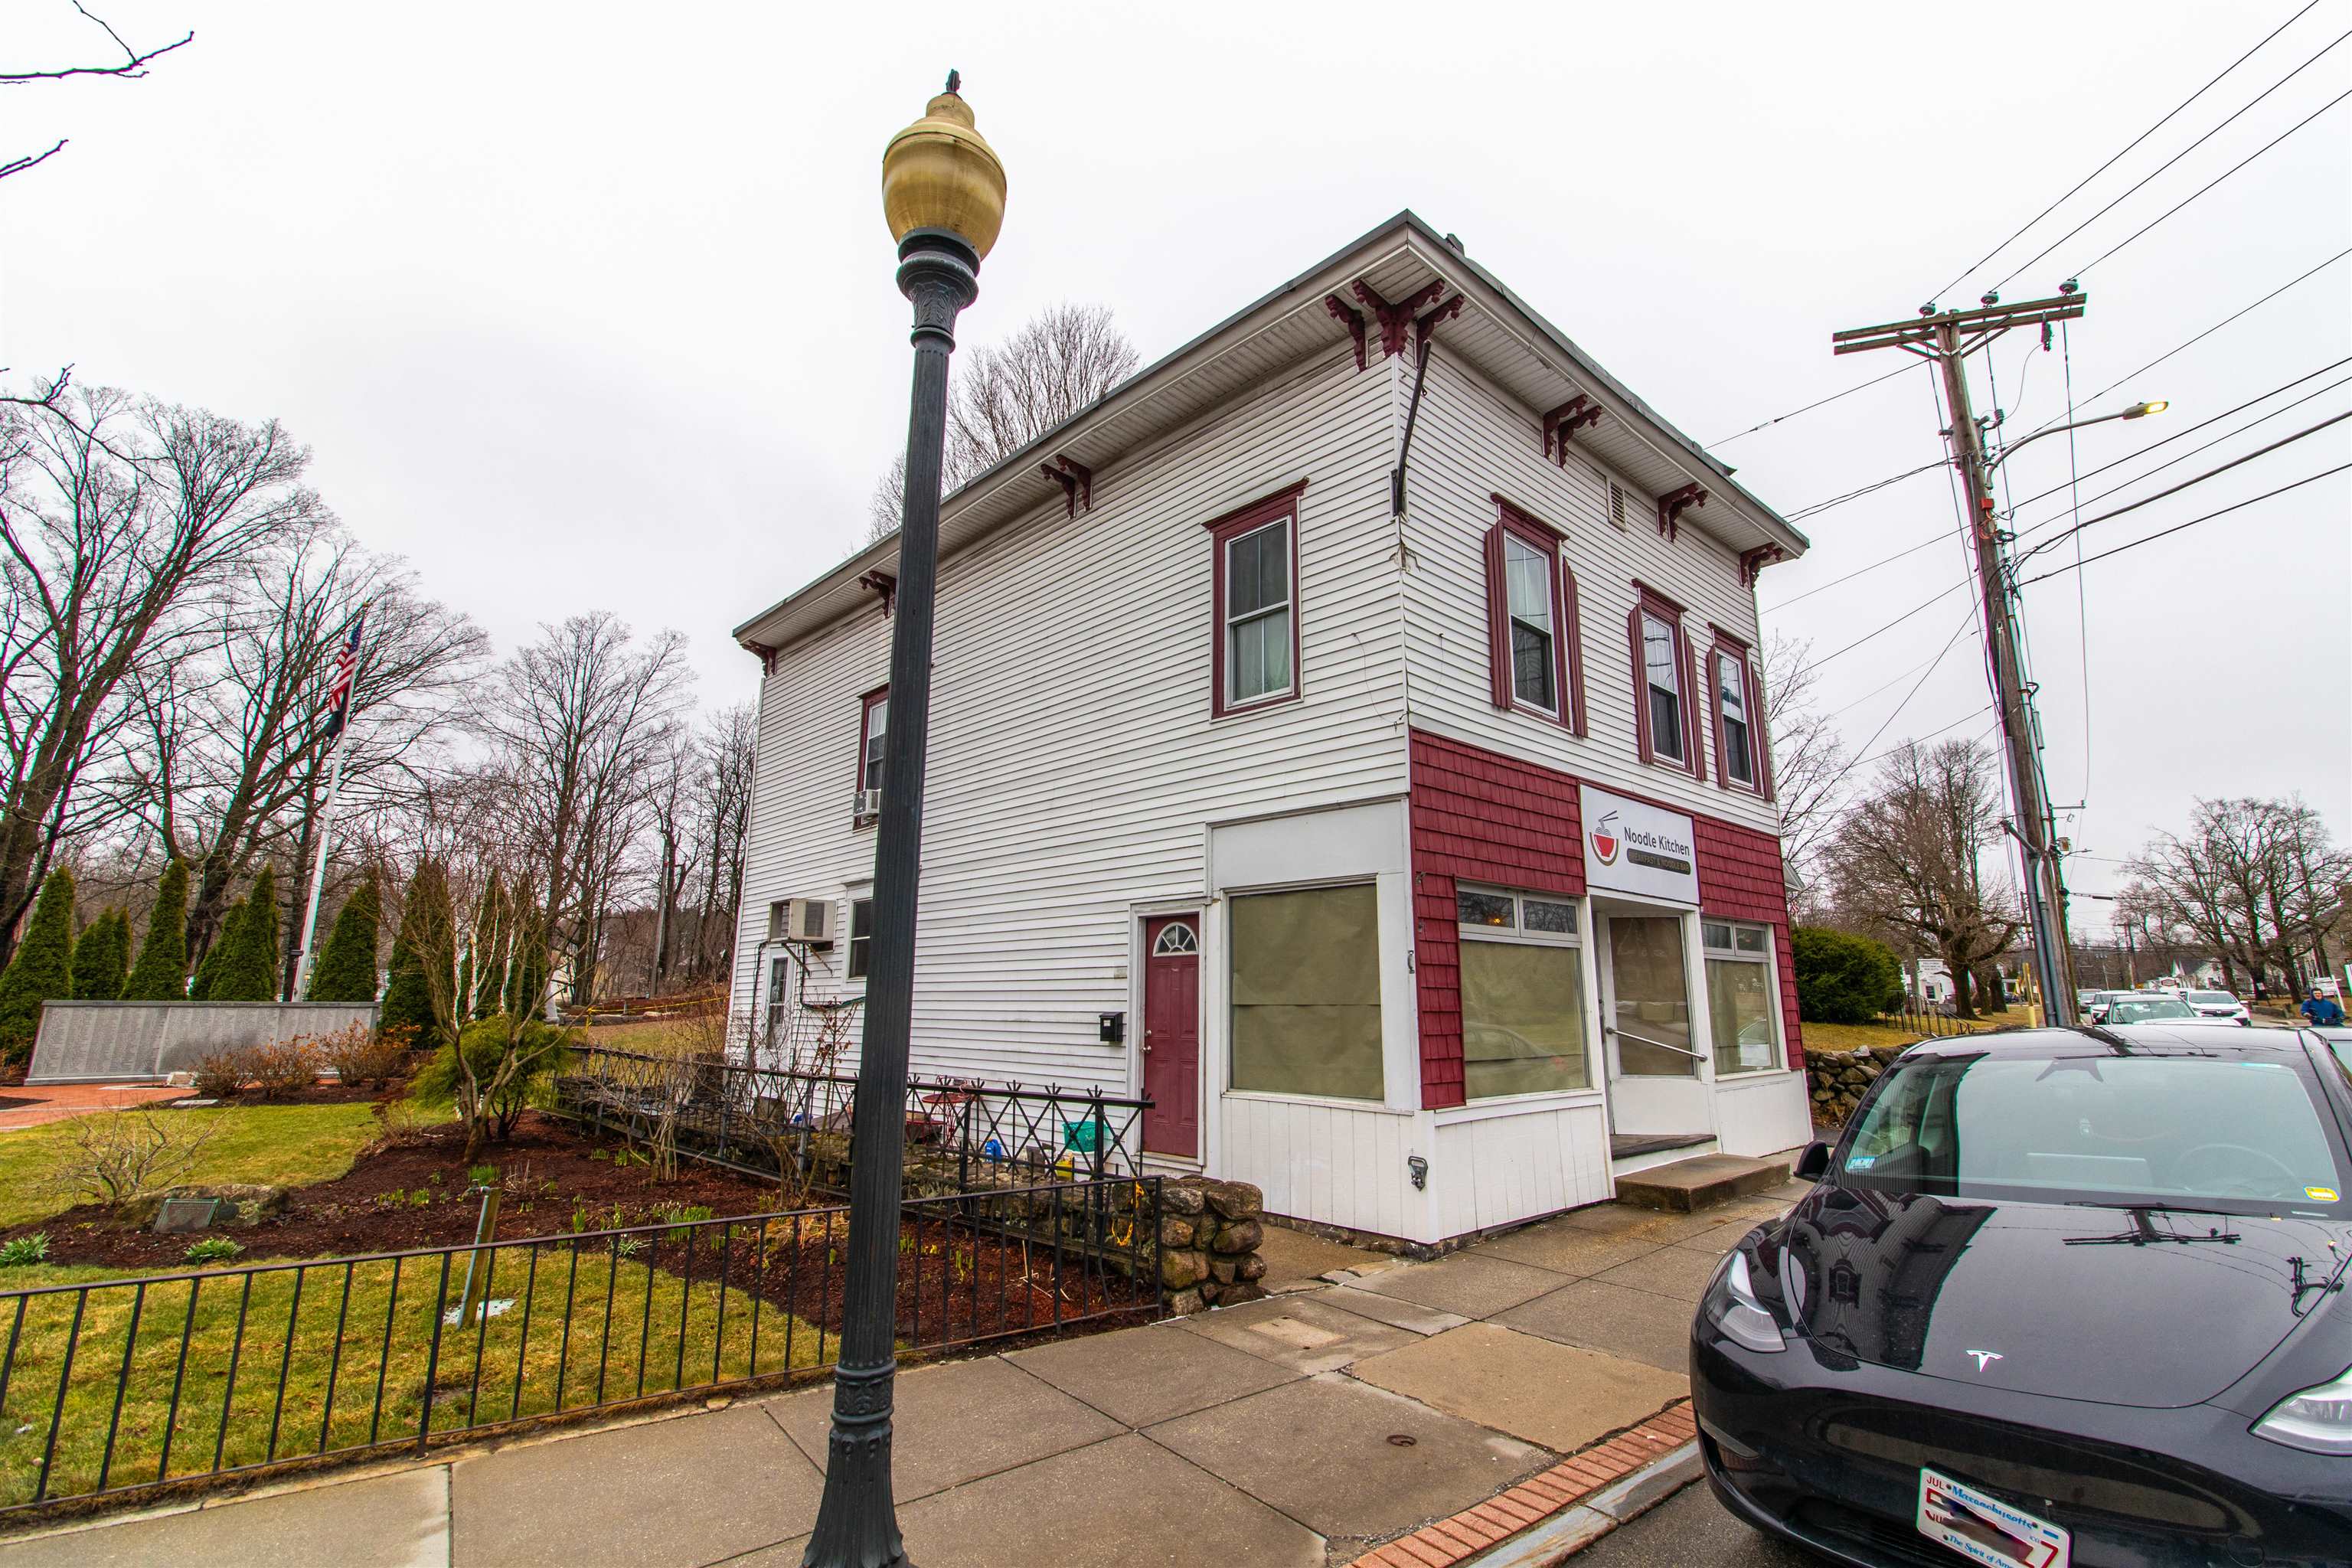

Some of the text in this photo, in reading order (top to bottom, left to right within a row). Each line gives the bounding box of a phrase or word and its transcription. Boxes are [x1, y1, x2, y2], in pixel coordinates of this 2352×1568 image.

[1624, 826, 1690, 856] Noodle Kitchen
[1926, 1476, 1945, 1490] JUL
[1949, 1534, 1963, 1547] The
[1965, 1543, 1984, 1557] Spirit
